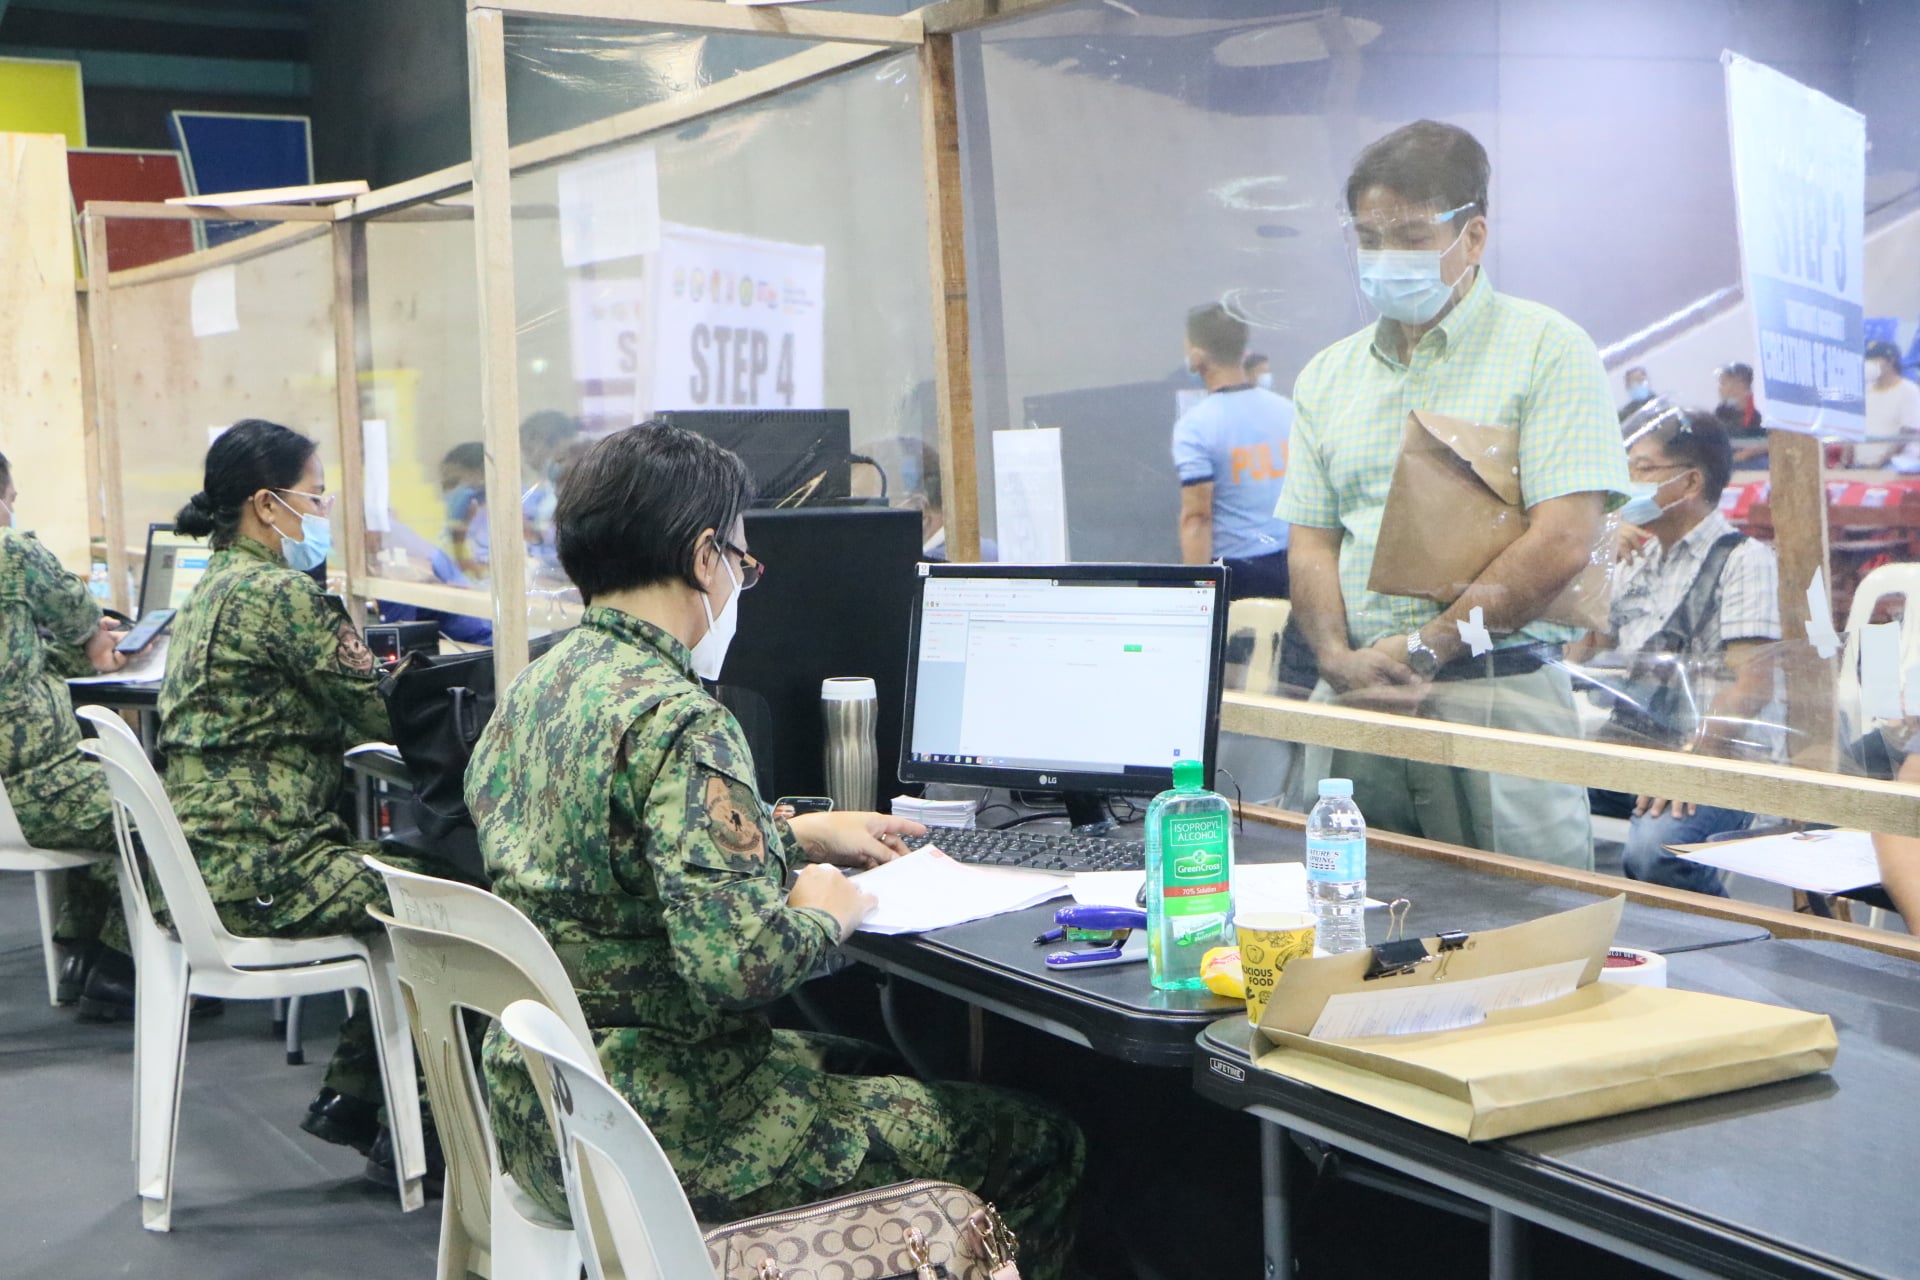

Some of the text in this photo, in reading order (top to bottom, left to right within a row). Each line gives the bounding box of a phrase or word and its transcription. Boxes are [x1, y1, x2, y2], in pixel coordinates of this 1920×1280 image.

[1775, 180, 1847, 292] STEP 3
[690, 322, 795, 406] STEP 4
[1047, 776, 1057, 784] LG
[1174, 821, 1220, 833] ISOPROPYL
[1177, 830, 1217, 842] ALCOHOL
[1177, 862, 1220, 873] GreenCross
[1249, 976, 1274, 986] FOOD
[1213, 1060, 1241, 1078] LIFETIME
